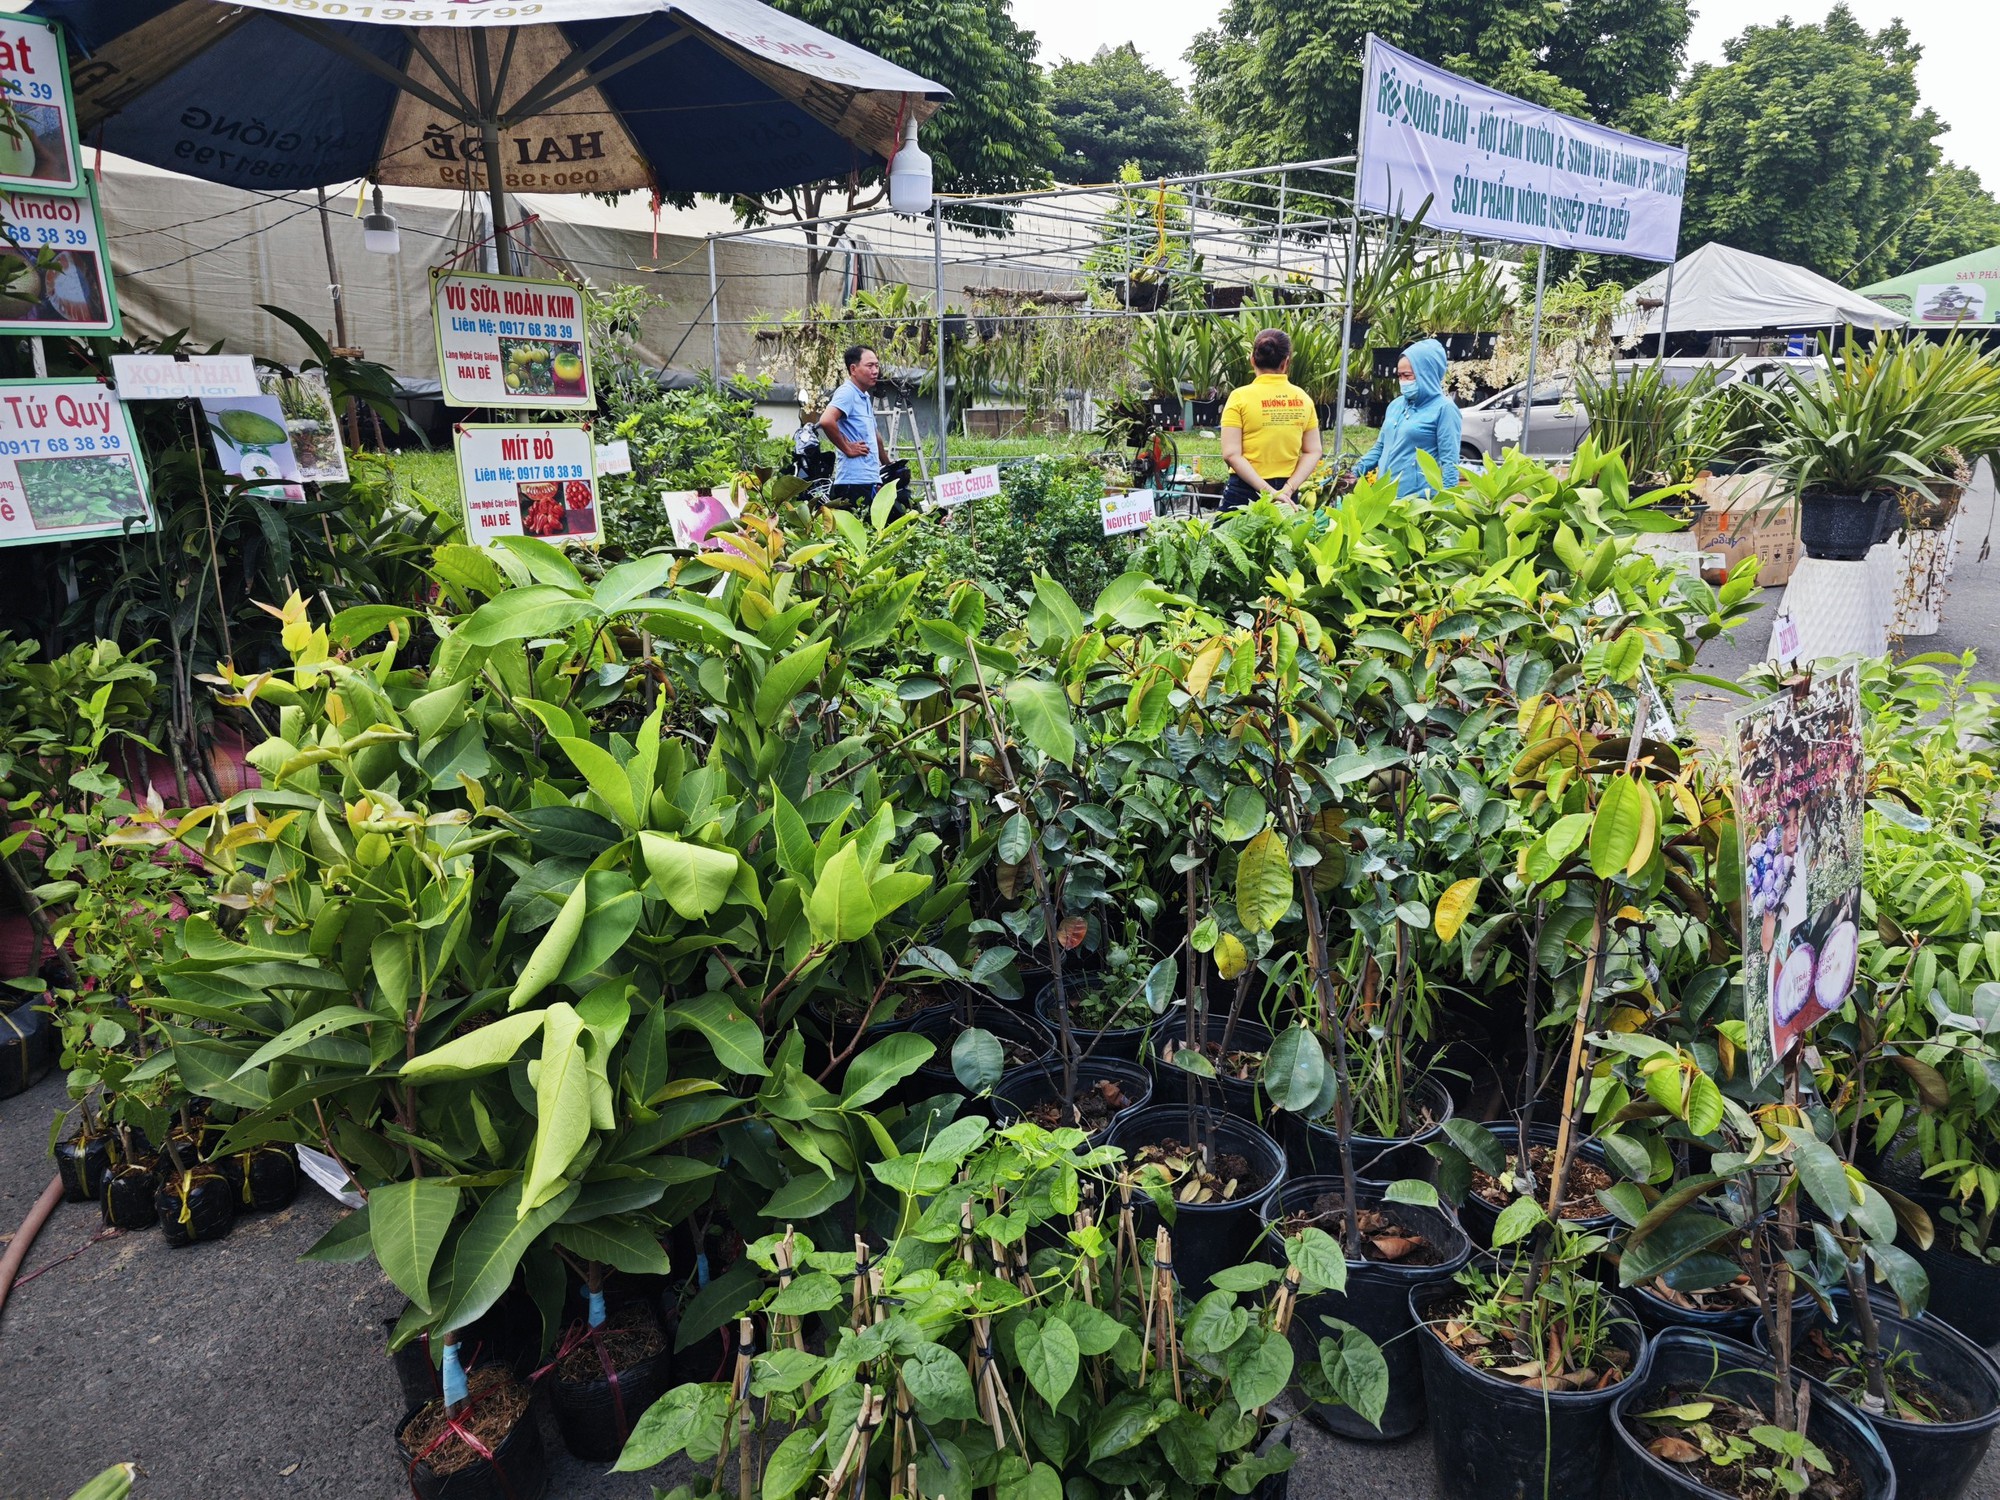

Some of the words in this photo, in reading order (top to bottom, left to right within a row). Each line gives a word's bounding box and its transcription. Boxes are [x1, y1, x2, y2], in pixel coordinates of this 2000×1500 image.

[29, 82, 53, 100] 39
[1401, 79, 1440, 137] NÔNG
[1442, 93, 1469, 145] DÂN
[1477, 106, 1499, 160] HỘI
[1499, 113, 1524, 160] LÀM
[1526, 121, 1555, 167] VƯỜN
[1556, 135, 1564, 170] &
[1567, 138, 1592, 176] SINH
[1593, 141, 1611, 187] VẬT
[1612, 142, 1637, 187] CẢNH
[11, 194, 81, 223] (indo)
[1452, 163, 1479, 216] SẢN
[1480, 169, 1515, 222] PHẨM
[1516, 183, 1548, 228] NÔNG
[1549, 193, 1585, 240] NGHIỆP
[1585, 198, 1608, 238] TIÊU
[1606, 197, 1630, 242] BIỂU
[8, 226, 31, 242] 68
[37, 227, 60, 243] 38
[65, 229, 88, 245] 39
[445, 282, 466, 311] VÚ
[470, 284, 501, 313] SỮA
[503, 288, 544, 317] HOÀN
[547, 295, 575, 319] KIM
[452, 316, 476, 332] Liên
[479, 318, 497, 337] Hệ:
[499, 320, 525, 336] 0917
[528, 322, 541, 337] 68
[544, 323, 557, 338] 38
[559, 325, 573, 339] 39
[458, 366, 476, 379] HAI
[477, 364, 491, 380] ĐÊ
[4, 395, 48, 428] Tứ
[55, 393, 110, 433] Quý
[0, 439, 40, 455] 0917
[47, 438, 69, 452] 68
[73, 437, 95, 451] 38
[99, 435, 121, 449] 39
[501, 434, 529, 461] MÍT
[533, 430, 554, 460] ĐỎ
[475, 467, 497, 482] Liên
[499, 467, 515, 483] Hệ:
[517, 466, 540, 480] 0917
[543, 466, 555, 479] 68
[557, 465, 569, 478] 38
[571, 465, 583, 477] 39
[965, 474, 994, 493] CHUA
[481, 514, 497, 528] HAI
[498, 510, 511, 526] ĐÊ
[1106, 511, 1137, 530] NGUYỆT
